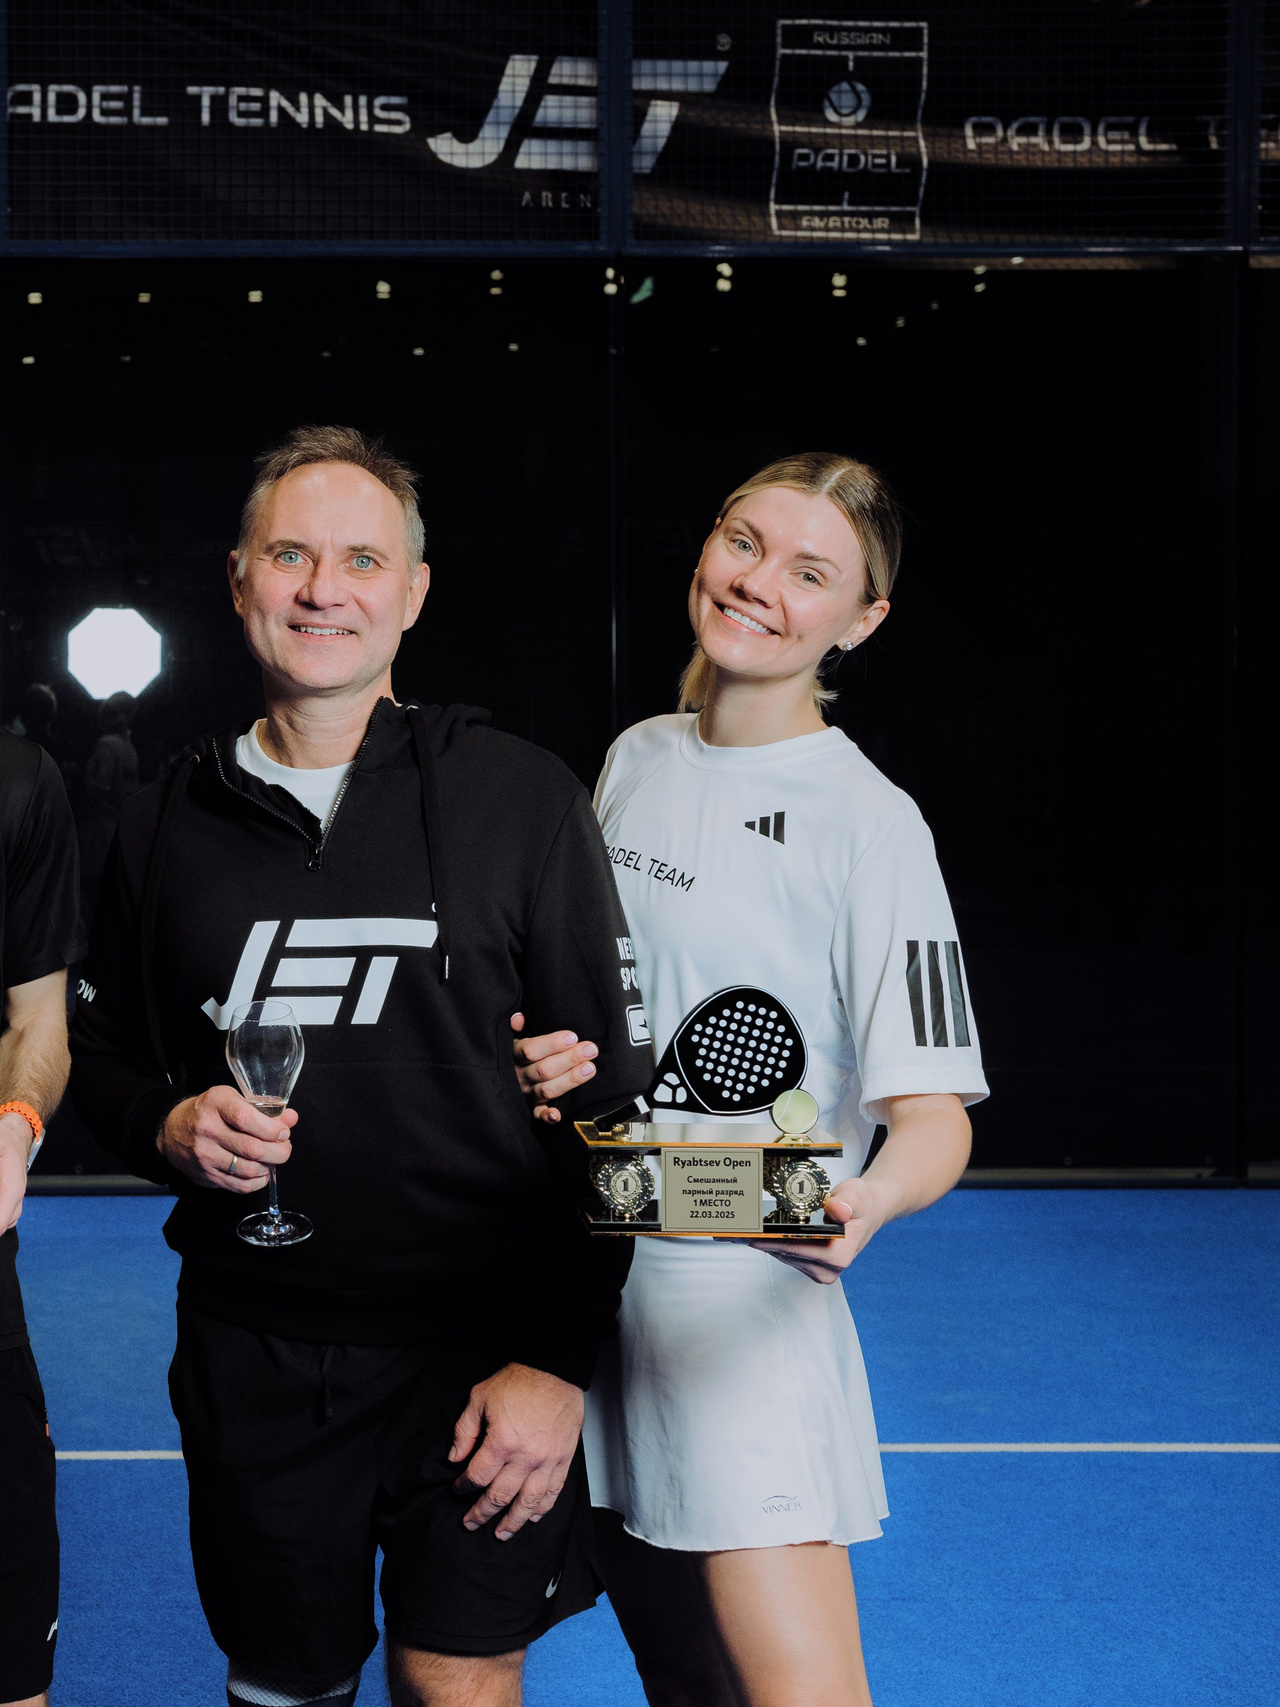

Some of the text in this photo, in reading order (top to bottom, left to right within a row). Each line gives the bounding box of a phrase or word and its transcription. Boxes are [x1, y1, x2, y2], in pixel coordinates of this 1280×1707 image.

[813, 31, 891, 45] RUSSIAN
[186, 85, 412, 134] TENNIS
[963, 116, 1179, 152] PADEL
[791, 148, 911, 173] PADEL
[521, 190, 593, 209] AREN
[647, 858, 695, 892] TEAM
[200, 917, 439, 1031] JET
[673, 1156, 751, 1170] Ryabtsev Open
[686, 1175, 738, 1184] Смешанный
[682, 1188, 744, 1199] парный разряд
[693, 1199, 732, 1207] 1 МЕСТО
[689, 1210, 736, 1219] 22.03.2025
